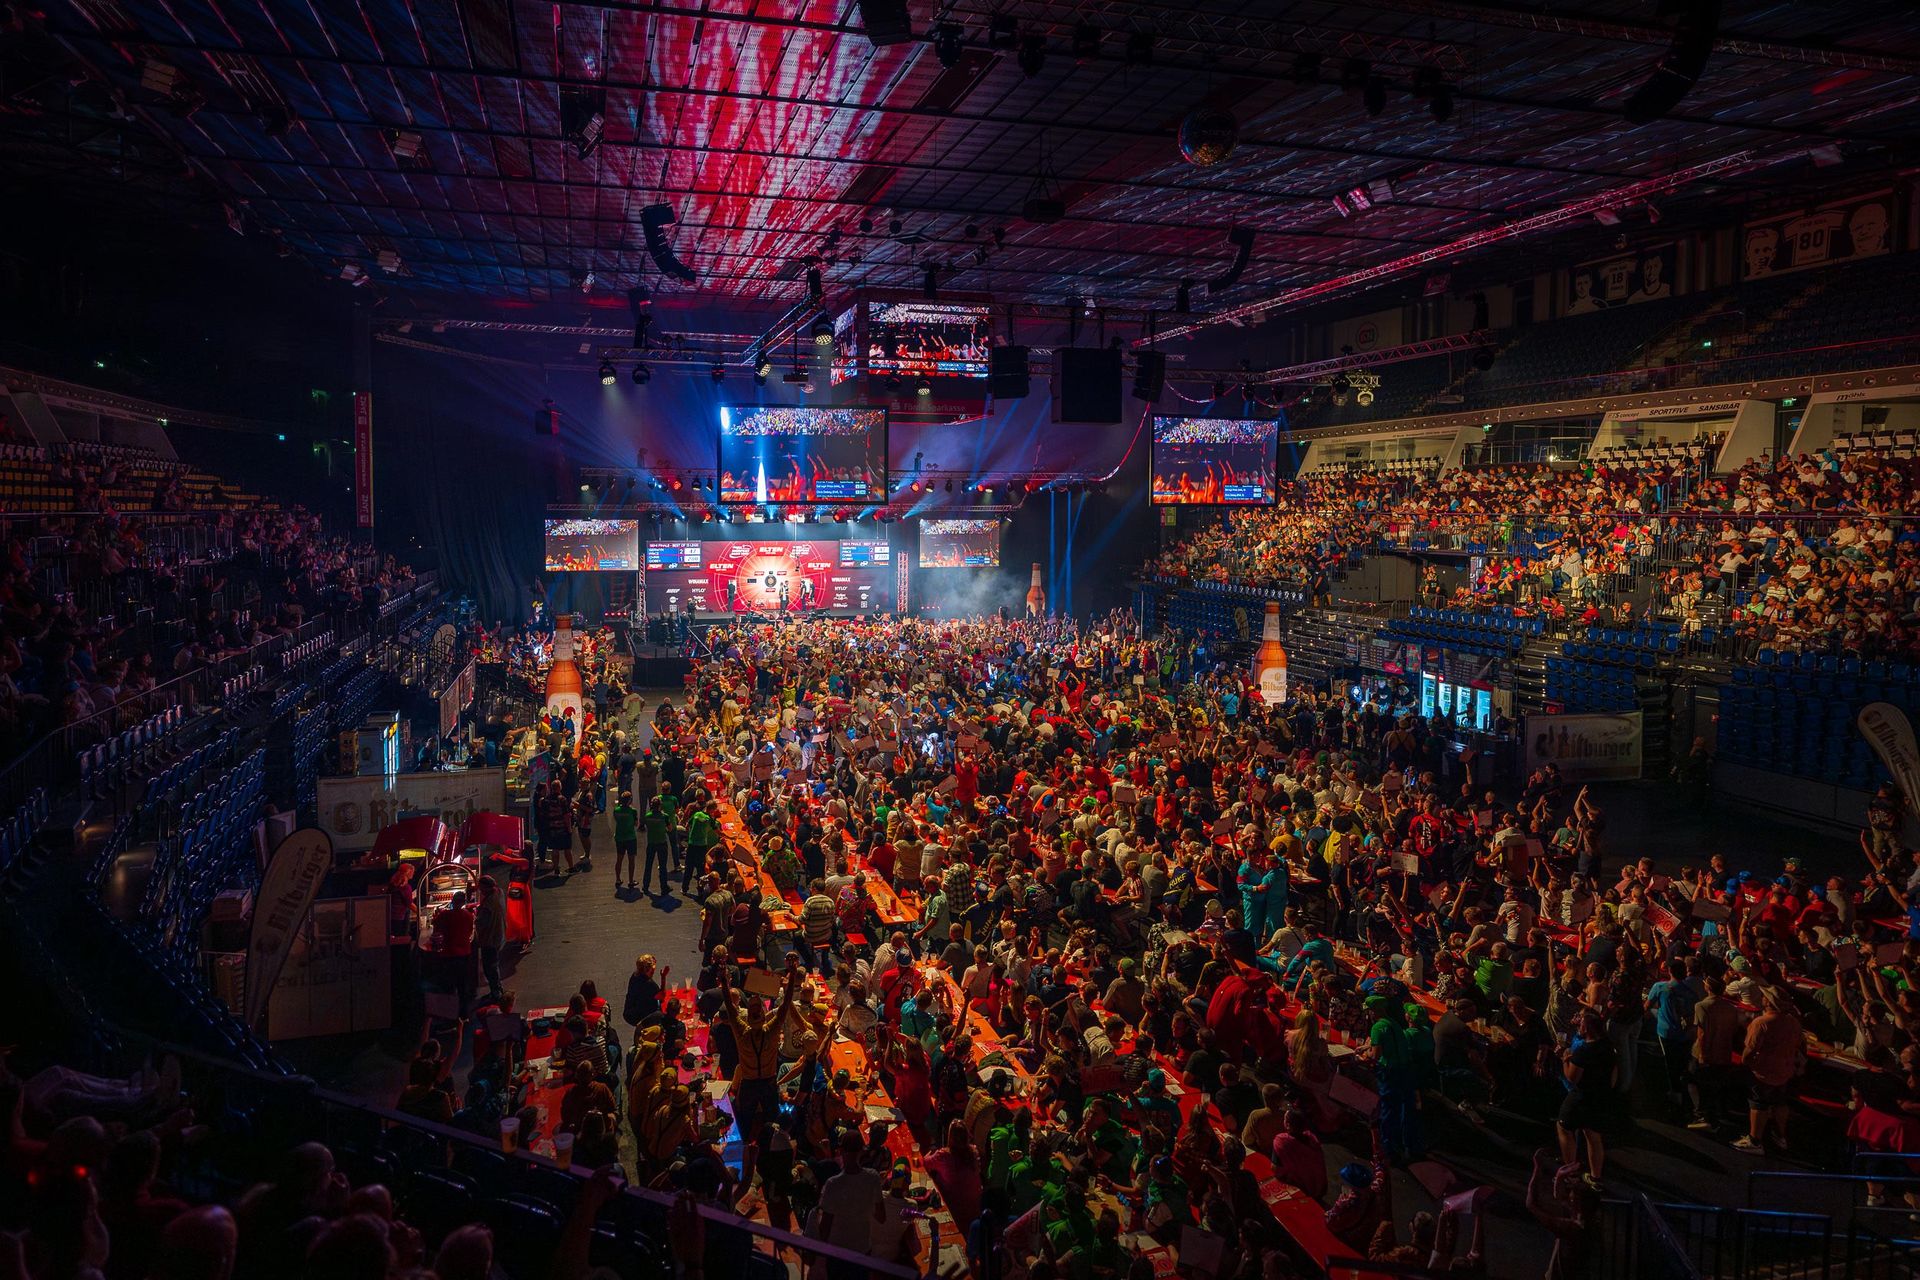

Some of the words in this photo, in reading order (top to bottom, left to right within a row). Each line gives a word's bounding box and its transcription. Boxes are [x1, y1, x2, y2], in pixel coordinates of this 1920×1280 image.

[1799, 229, 1824, 250] 80
[1648, 407, 1689, 416] SPORTFIVE
[266, 844, 328, 932] Bitburger
